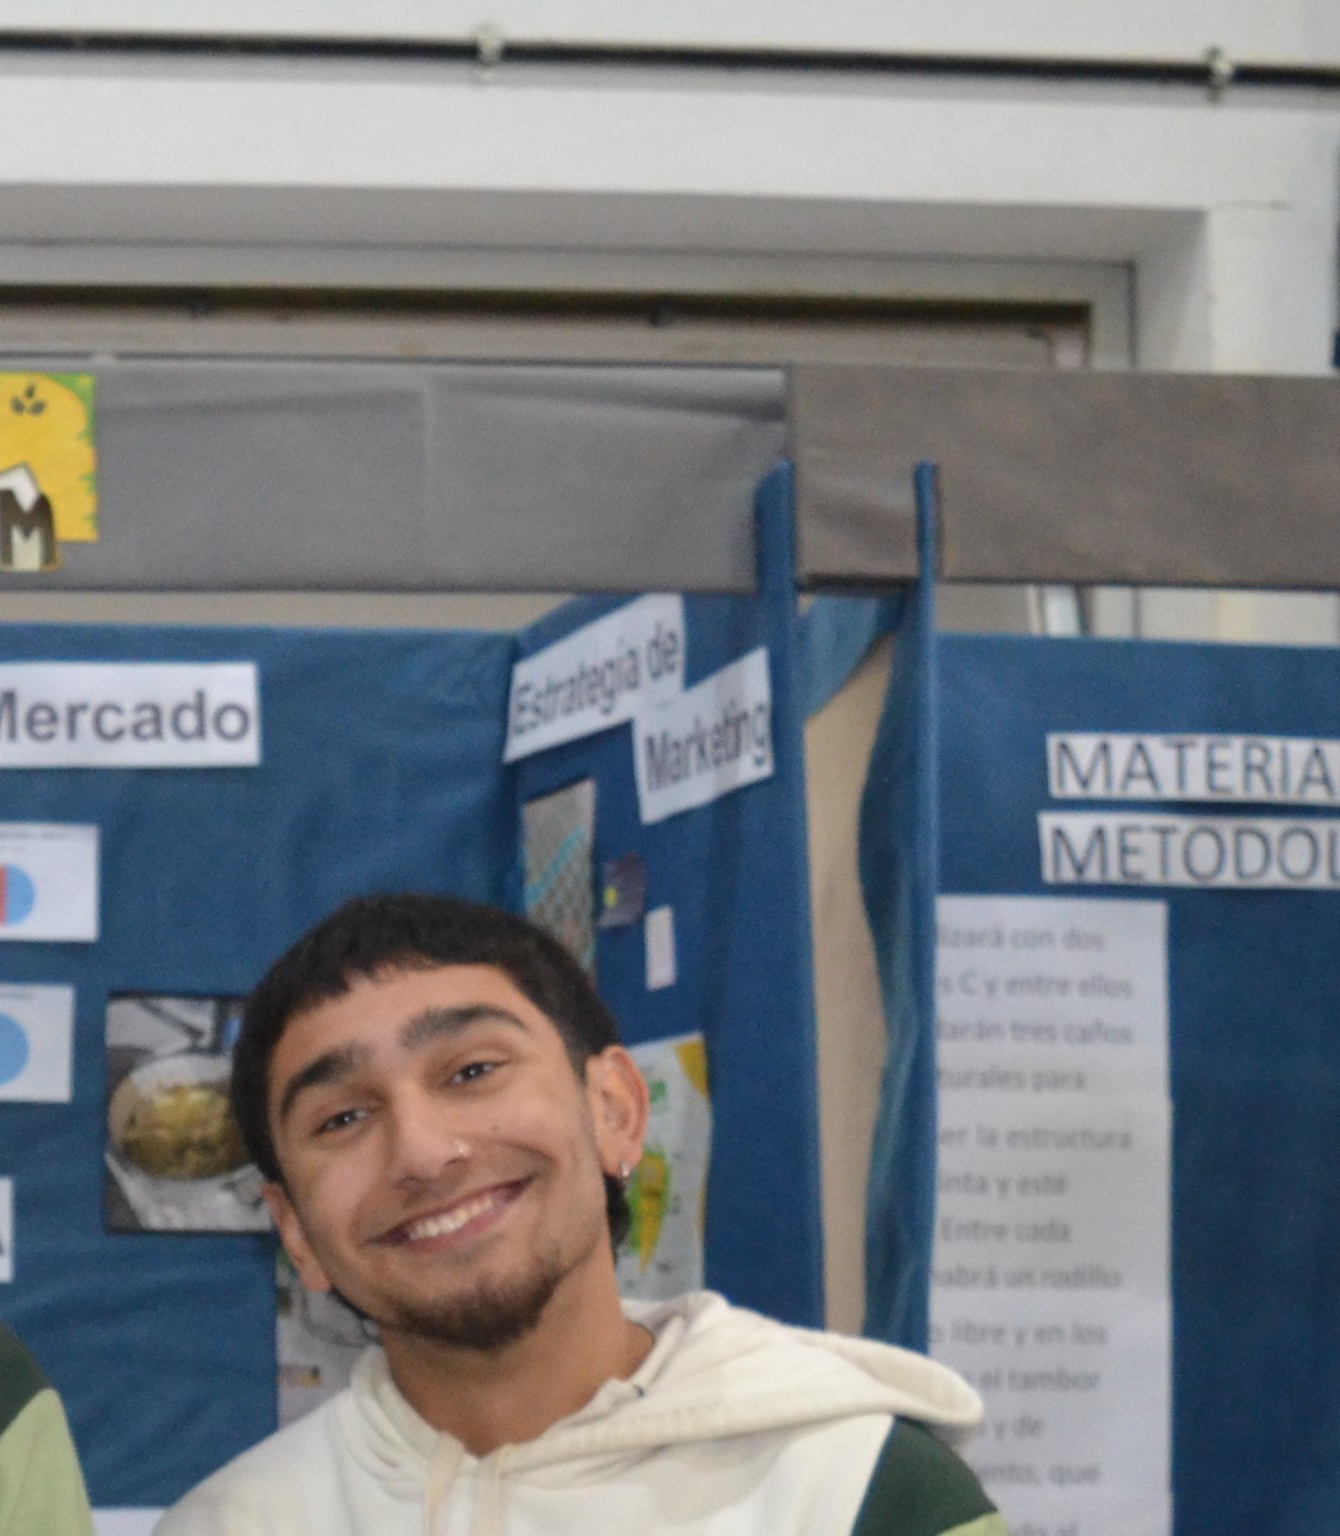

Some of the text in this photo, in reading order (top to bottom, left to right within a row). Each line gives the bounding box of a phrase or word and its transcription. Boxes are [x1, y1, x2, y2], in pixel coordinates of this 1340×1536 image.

[514, 620, 678, 735] Estrategia de
[644, 699, 766, 793] Marketing
[1058, 741, 1336, 798] MATERIA
